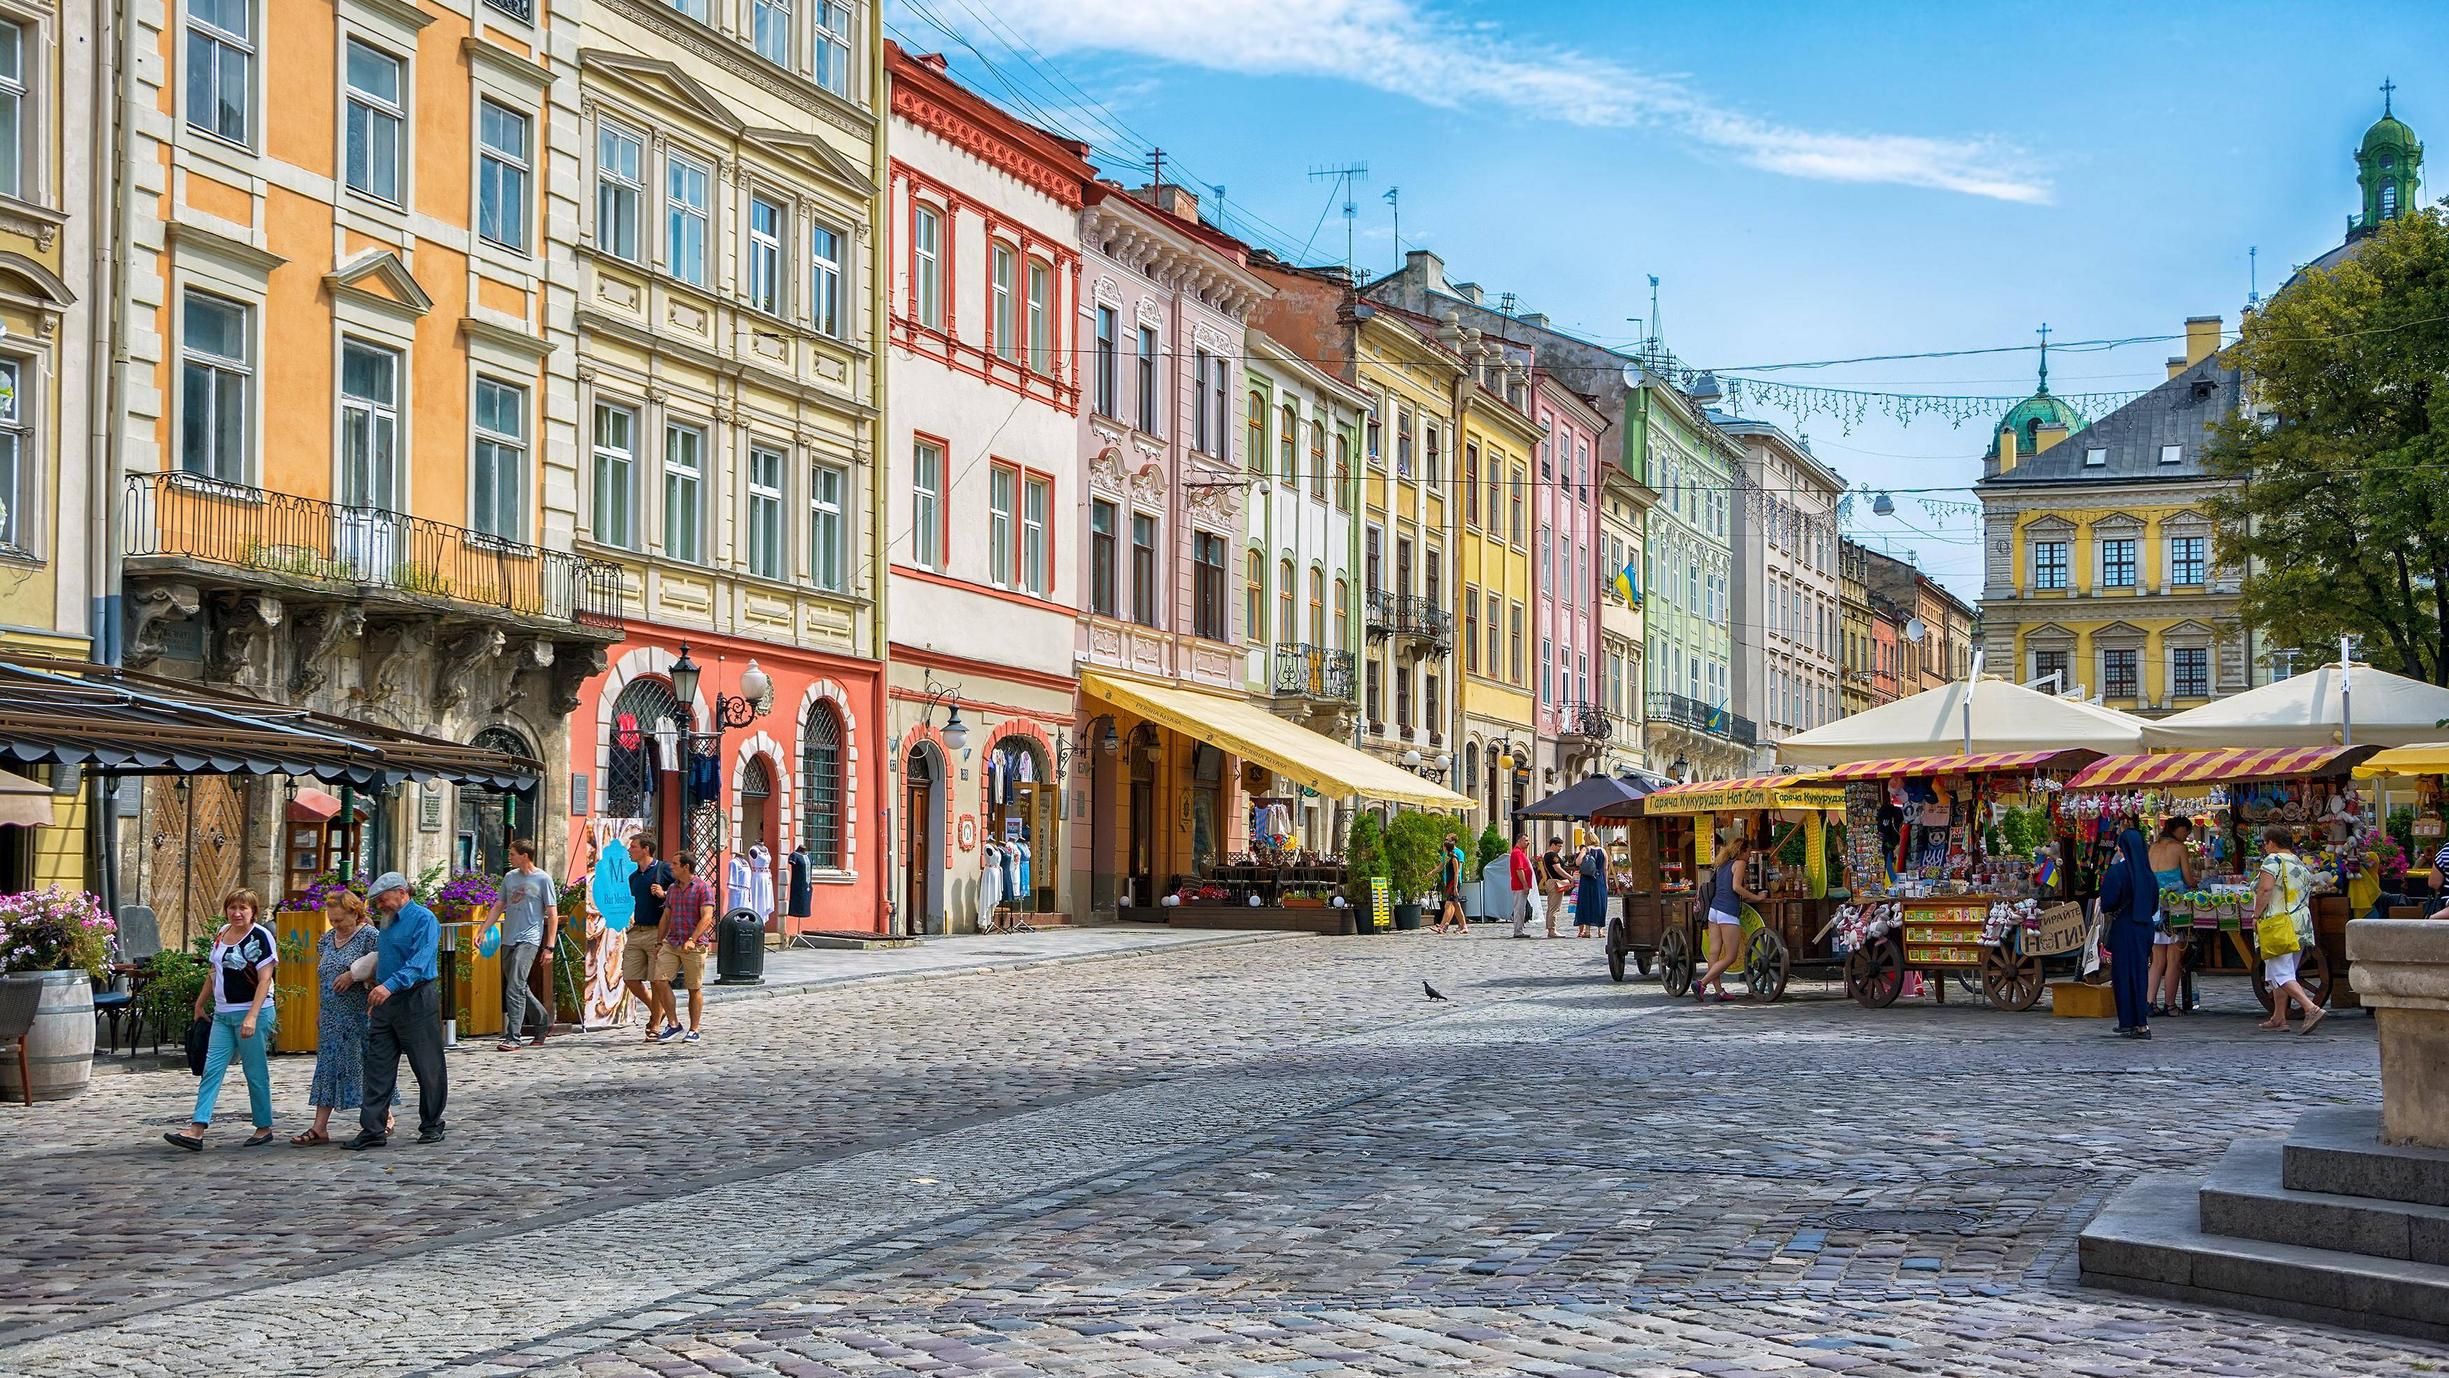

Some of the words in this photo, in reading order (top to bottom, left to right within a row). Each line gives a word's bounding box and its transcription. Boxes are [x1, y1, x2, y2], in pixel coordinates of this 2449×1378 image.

[1649, 796, 1677, 812] Гаряча
[1680, 792, 1723, 810] Кукурудза
[1727, 789, 1742, 805] Hot
[1744, 789, 1764, 804] Corn
[1774, 792, 1801, 803] Гаряча
[608, 856, 624, 883] M
[2040, 907, 2080, 926] ТИРАЙТЕ
